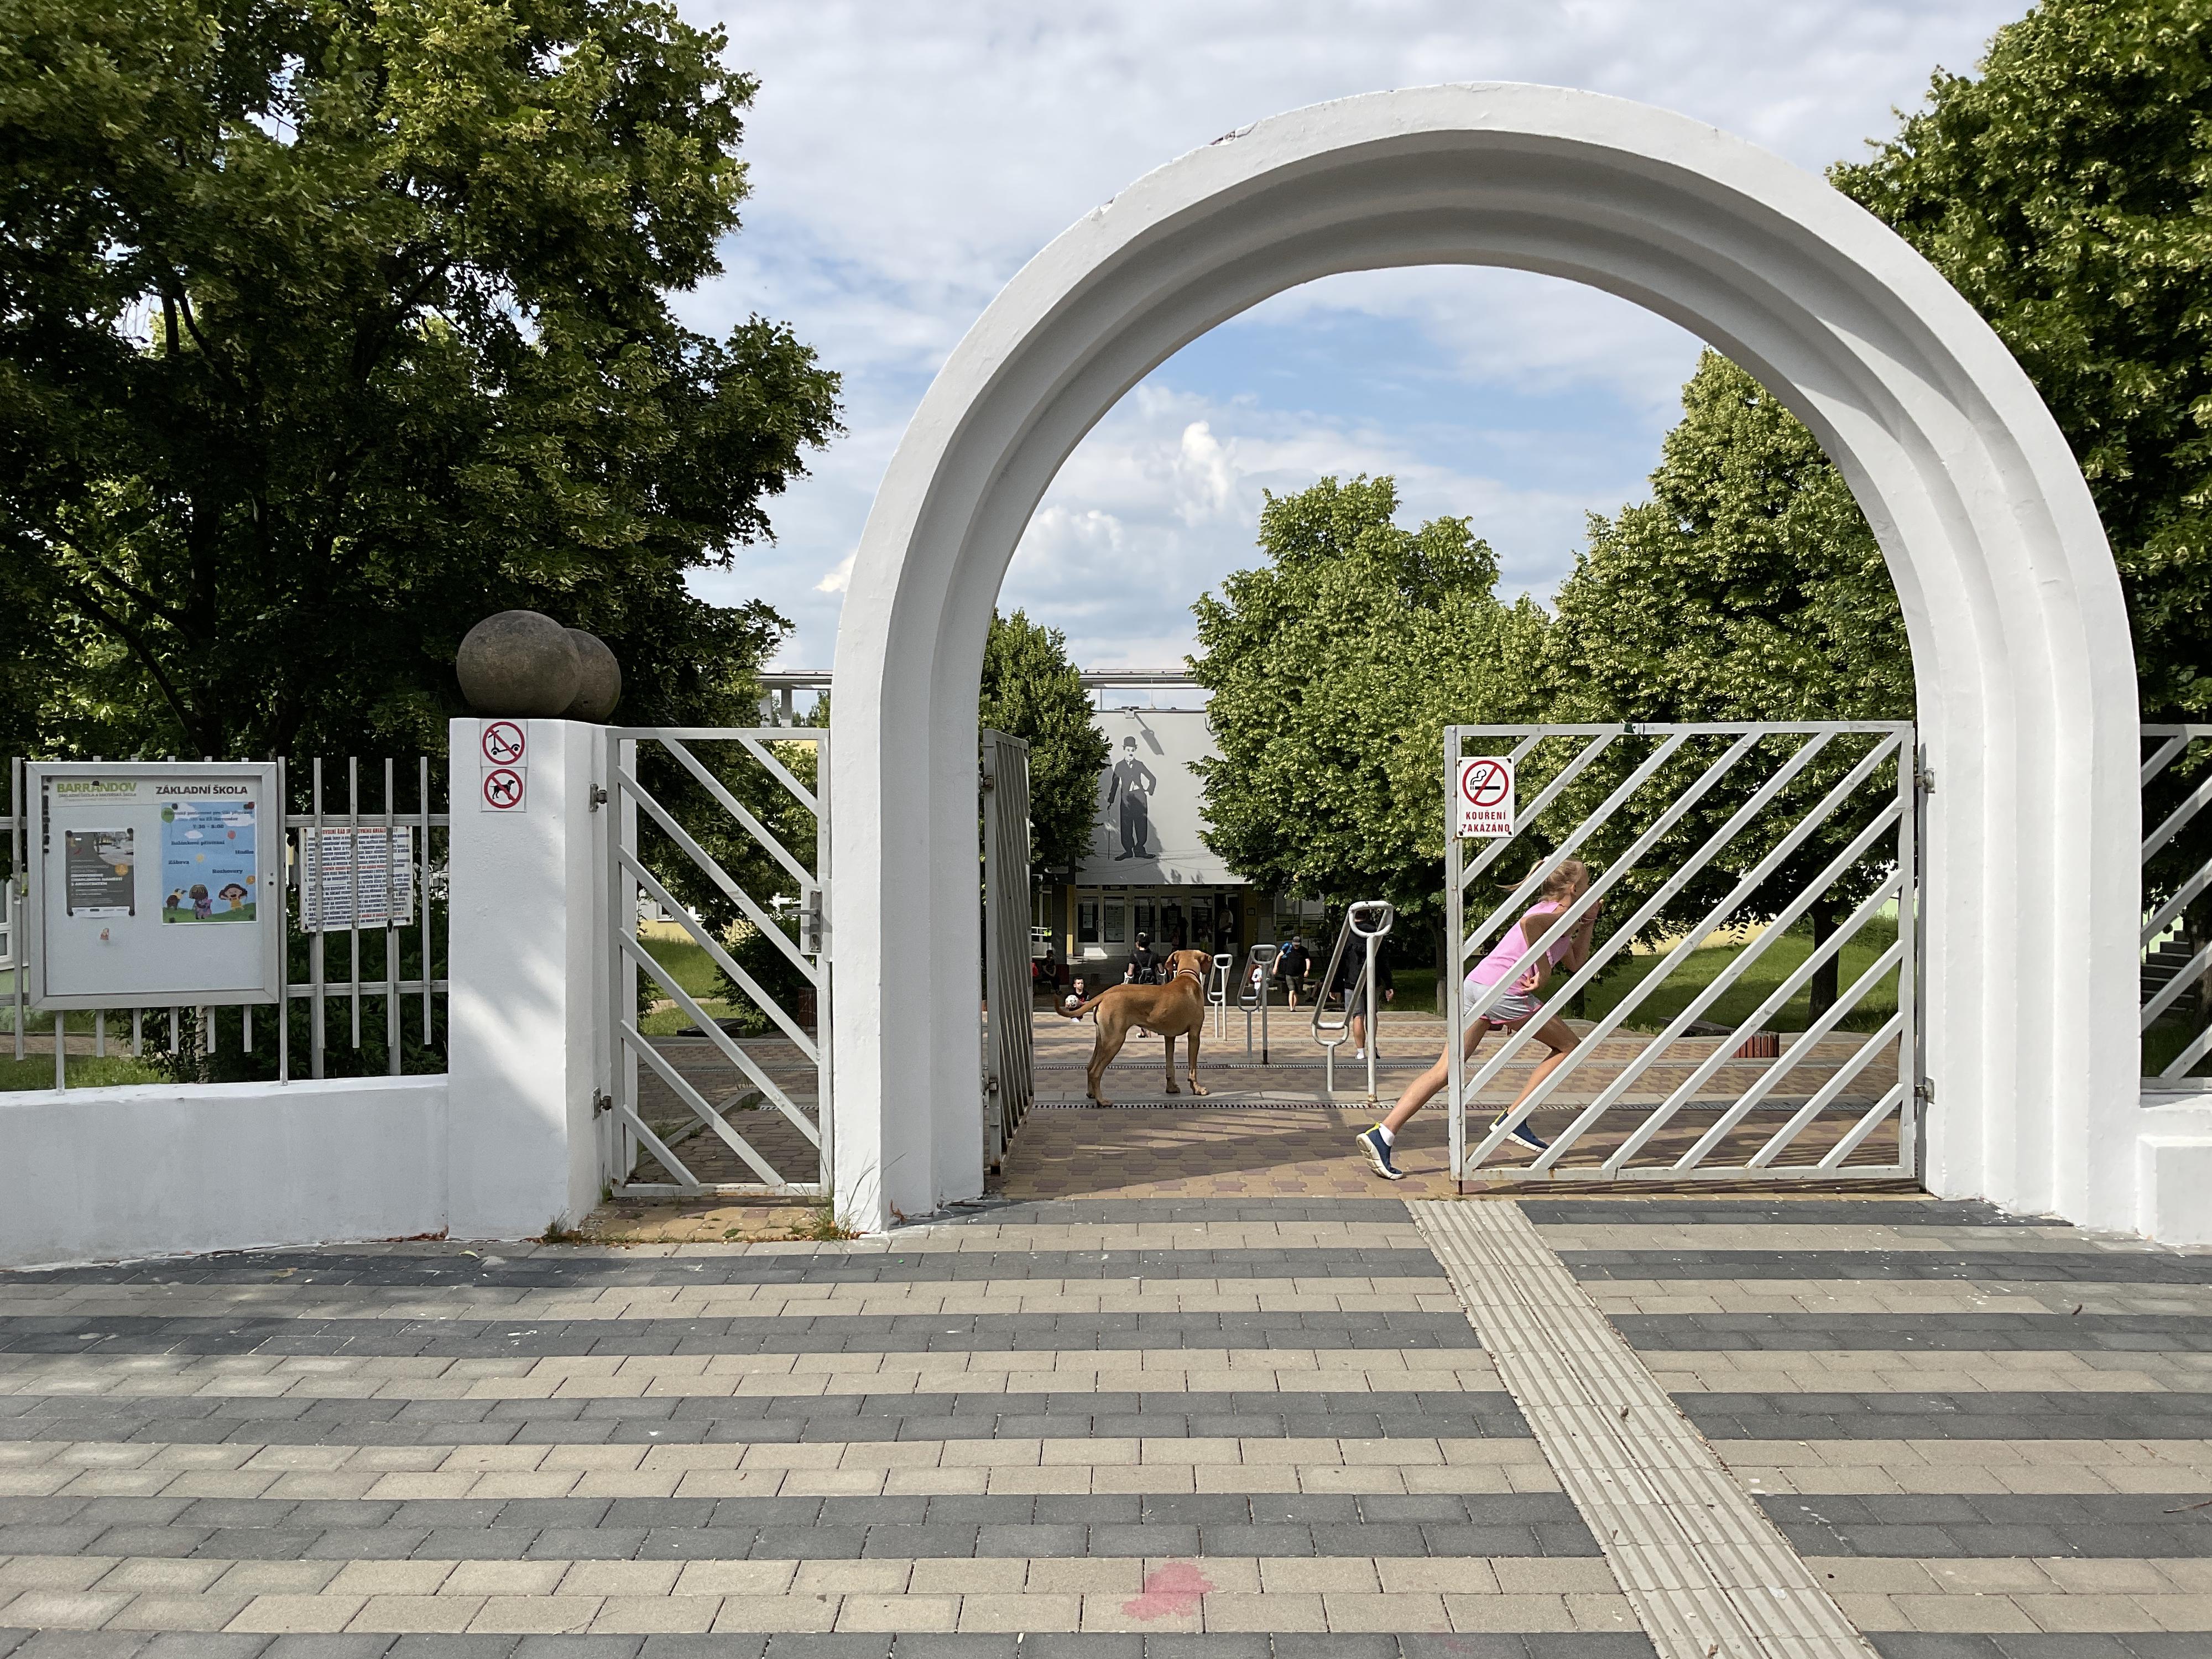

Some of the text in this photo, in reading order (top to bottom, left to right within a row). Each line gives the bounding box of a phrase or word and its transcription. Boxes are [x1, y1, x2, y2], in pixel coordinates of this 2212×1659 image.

[57, 782, 137, 792] BARRANDOV
[155, 784, 248, 794] ZÁKLADNÍ ŠKOLA
[1465, 810, 1506, 820] KOUŘENÍ
[1462, 822, 1510, 832] ZAKÁZÁNO
